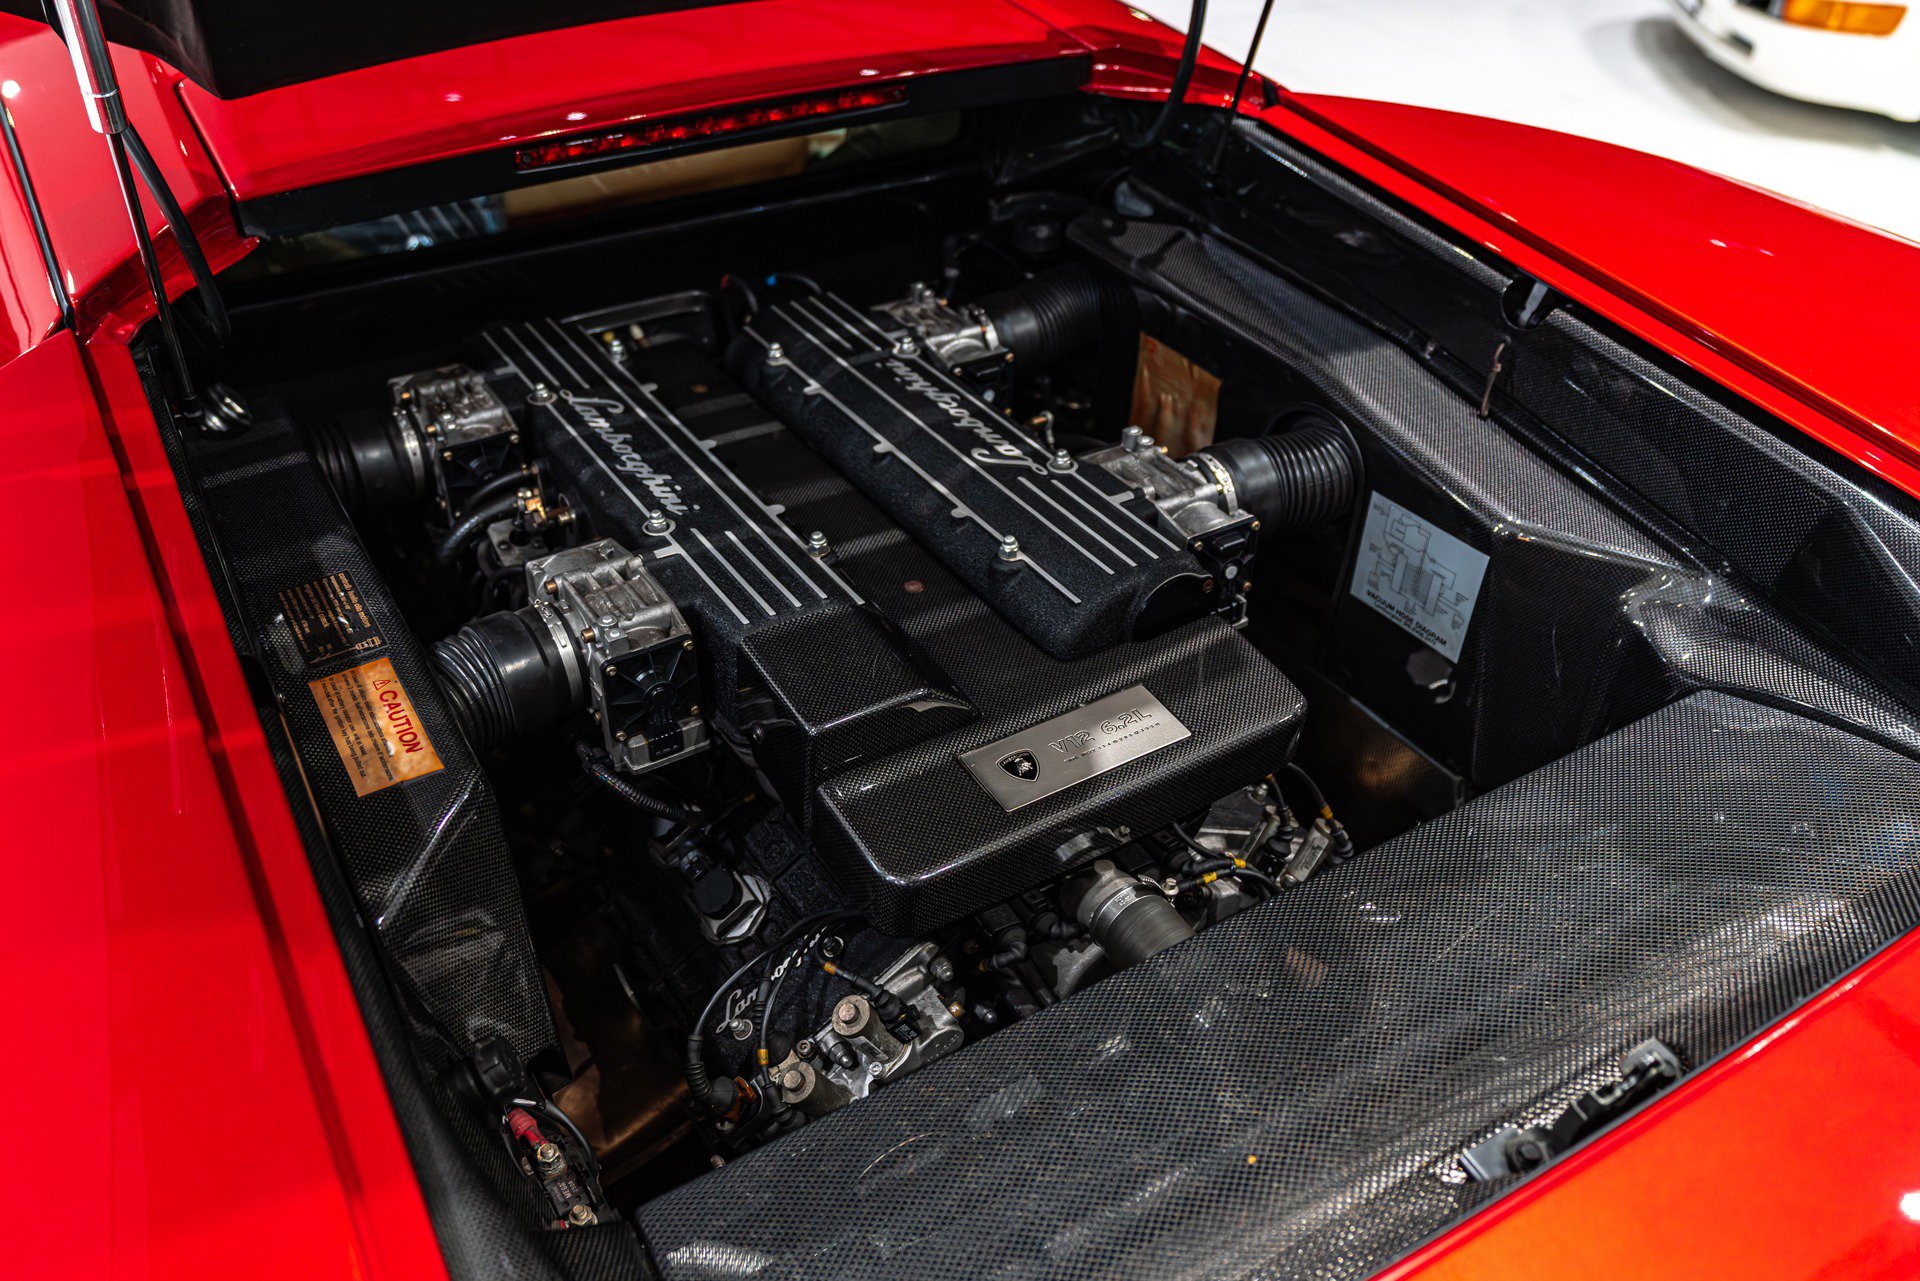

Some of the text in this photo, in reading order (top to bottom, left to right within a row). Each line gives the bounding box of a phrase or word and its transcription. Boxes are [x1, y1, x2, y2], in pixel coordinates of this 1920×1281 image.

[875, 358, 1048, 475] Lamborghini
[559, 389, 700, 516] Lamborghini
[1367, 590, 1395, 611] VACUUM
[1395, 609, 1414, 624] HOSE
[1414, 622, 1447, 646] DIAGRAM
[379, 690, 423, 753] CAUTION
[1048, 709, 1152, 754] V12 6.2L
